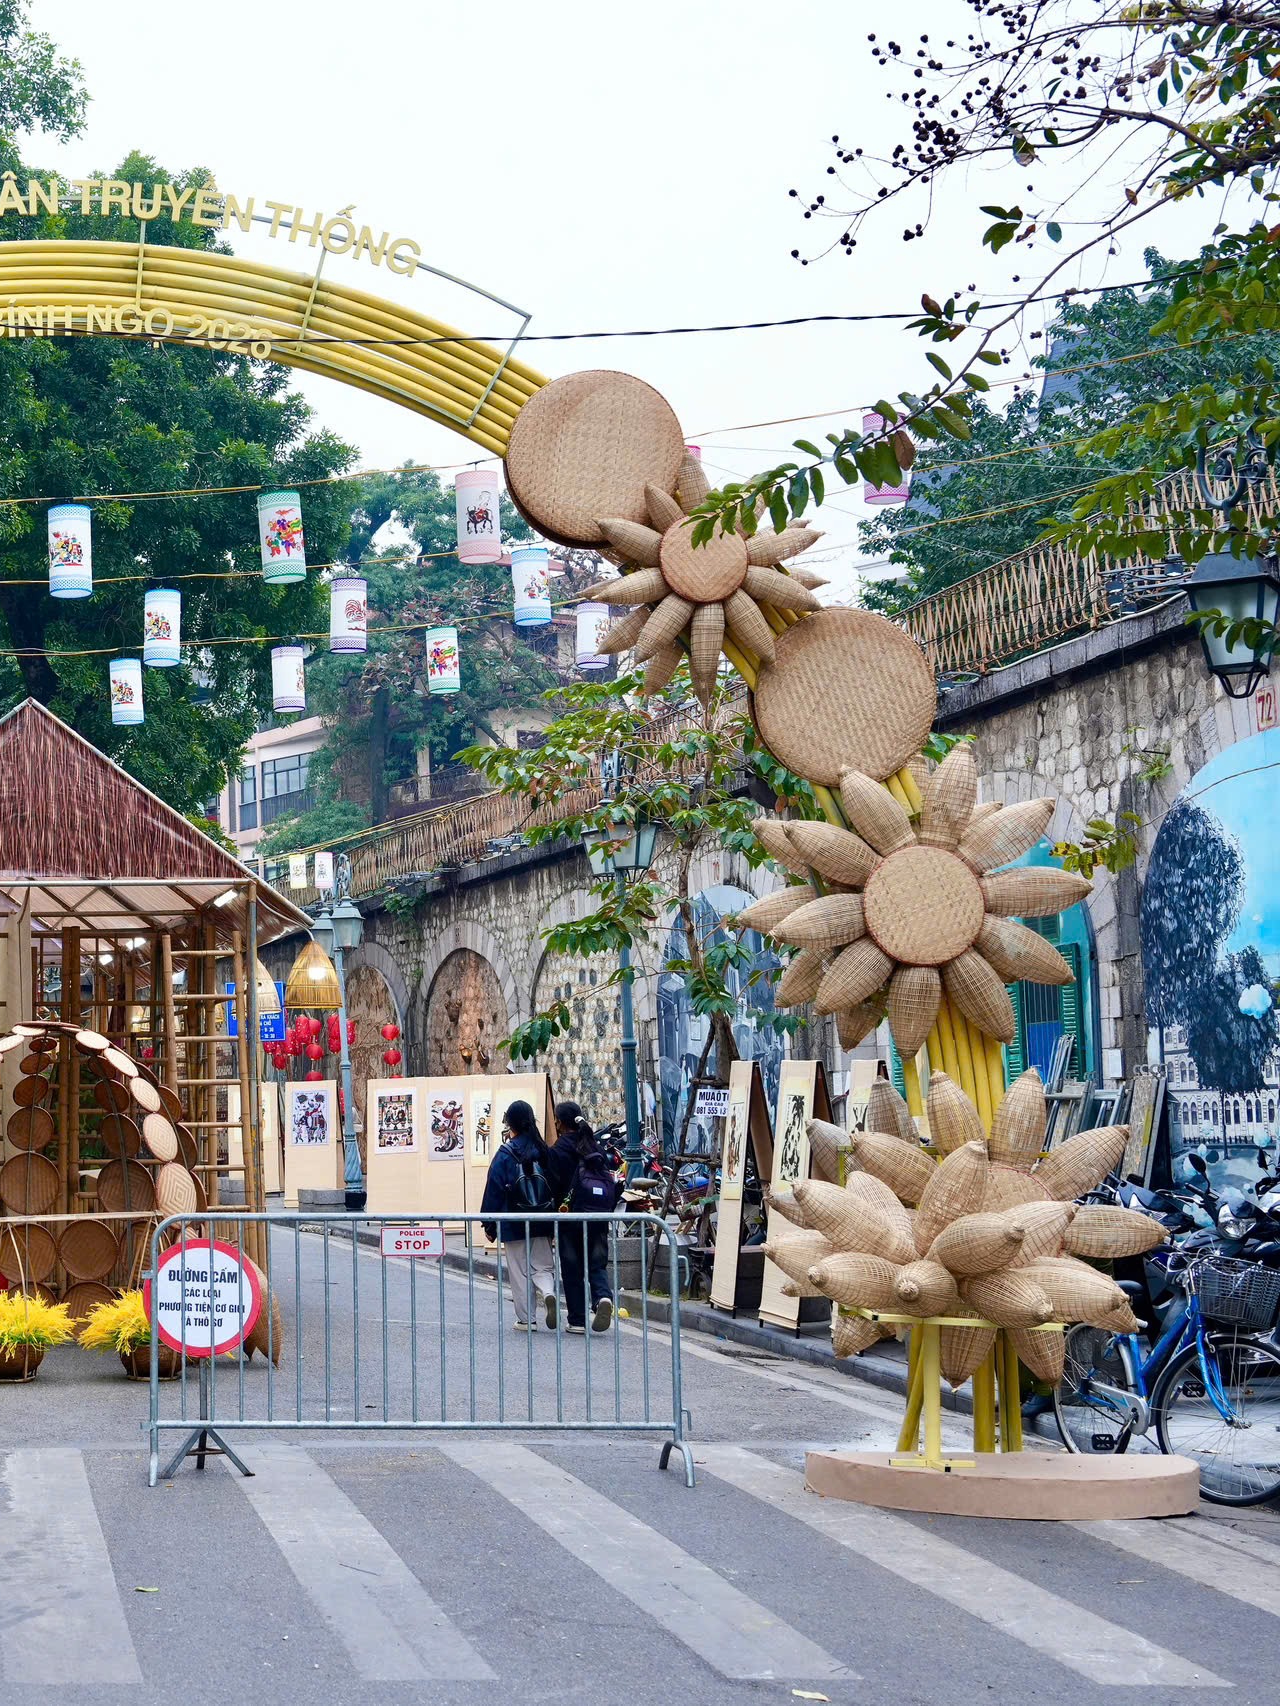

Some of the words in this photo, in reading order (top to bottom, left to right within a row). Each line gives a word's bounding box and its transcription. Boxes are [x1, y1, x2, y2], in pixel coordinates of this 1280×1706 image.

[265, 204, 422, 278] THỐNG
[86, 304, 173, 348] NGỌ
[184, 314, 272, 359] 2026
[1257, 692, 1273, 723] 72
[395, 1240, 430, 1250] STOP
[213, 1267, 238, 1284] CẤM
[184, 1287, 201, 1298] CÁC
[215, 1302, 227, 1313] CƠ
